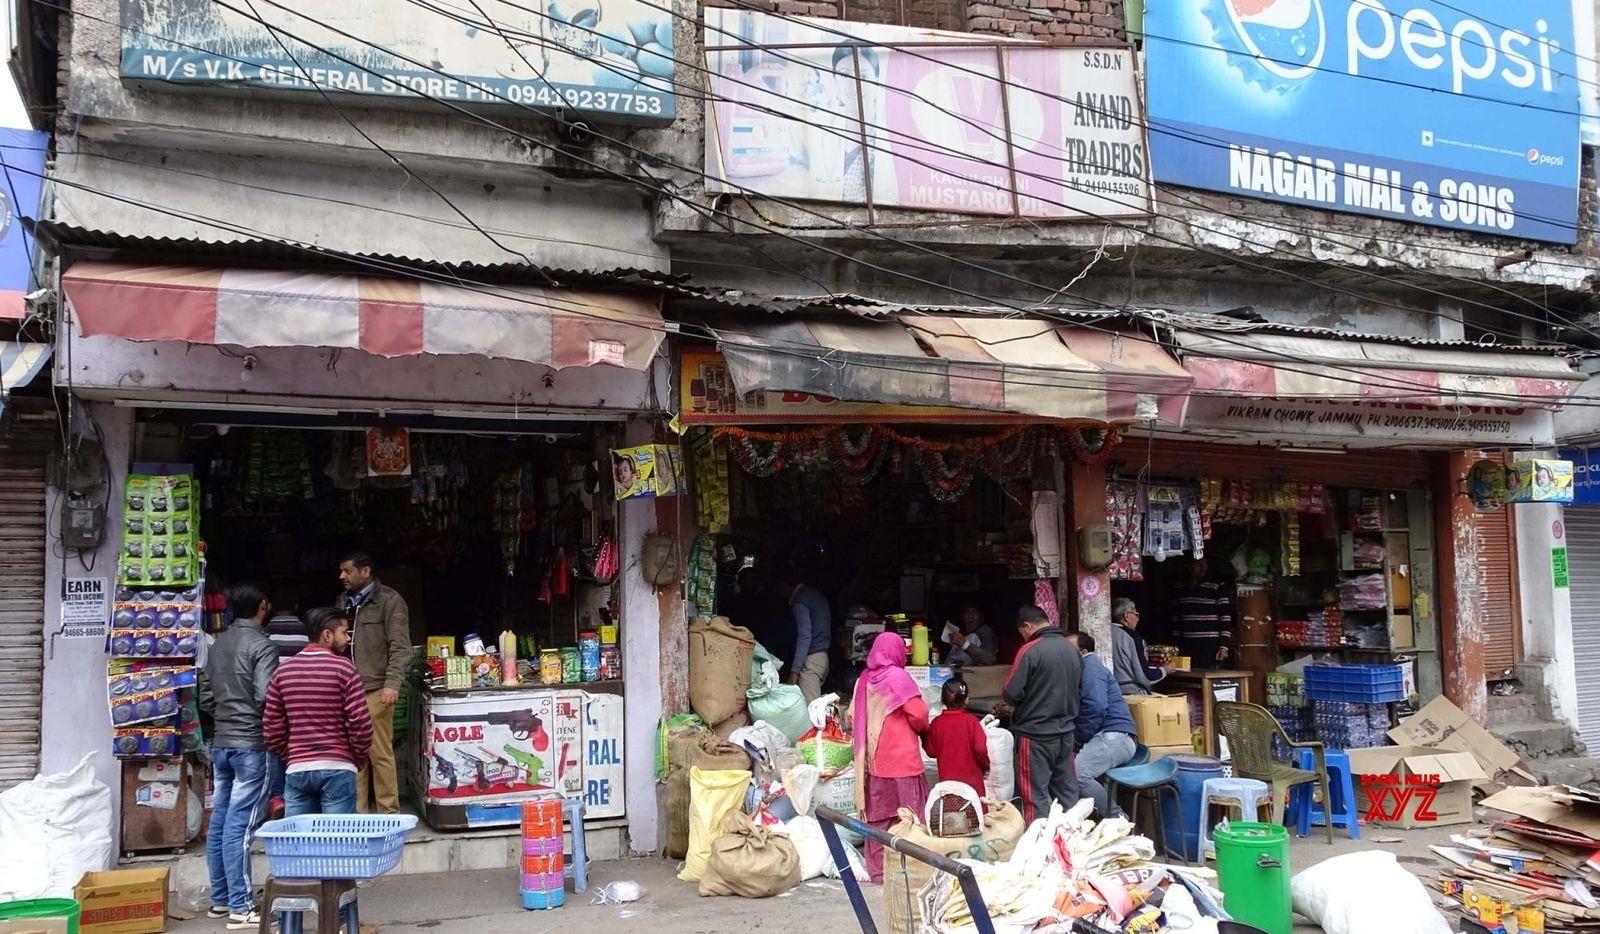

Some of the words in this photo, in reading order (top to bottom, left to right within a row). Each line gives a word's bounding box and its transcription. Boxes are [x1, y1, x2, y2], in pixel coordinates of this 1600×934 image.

[1083, 50, 1122, 71] S.S.D.N
[1347, 0, 1553, 94] pepsi
[142, 54, 198, 80] M/s
[259, 64, 376, 94] GENERAL
[381, 72, 459, 99] STORE
[507, 84, 662, 115] 09419237753
[1074, 91, 1132, 131] ANAND
[1065, 136, 1143, 180] TRADERS
[1539, 153, 1564, 166] pepsi
[910, 184, 1009, 210] MUSTARD
[1229, 143, 1337, 203] NAGAR
[1343, 162, 1406, 214] MAL
[1411, 180, 1434, 218] &
[1439, 178, 1515, 230] SONS
[1226, 405, 1272, 420] VIKRAM
[1274, 408, 1315, 424] CHOWK
[1318, 411, 1363, 425] JAMMU
[67, 580, 102, 593] EARN
